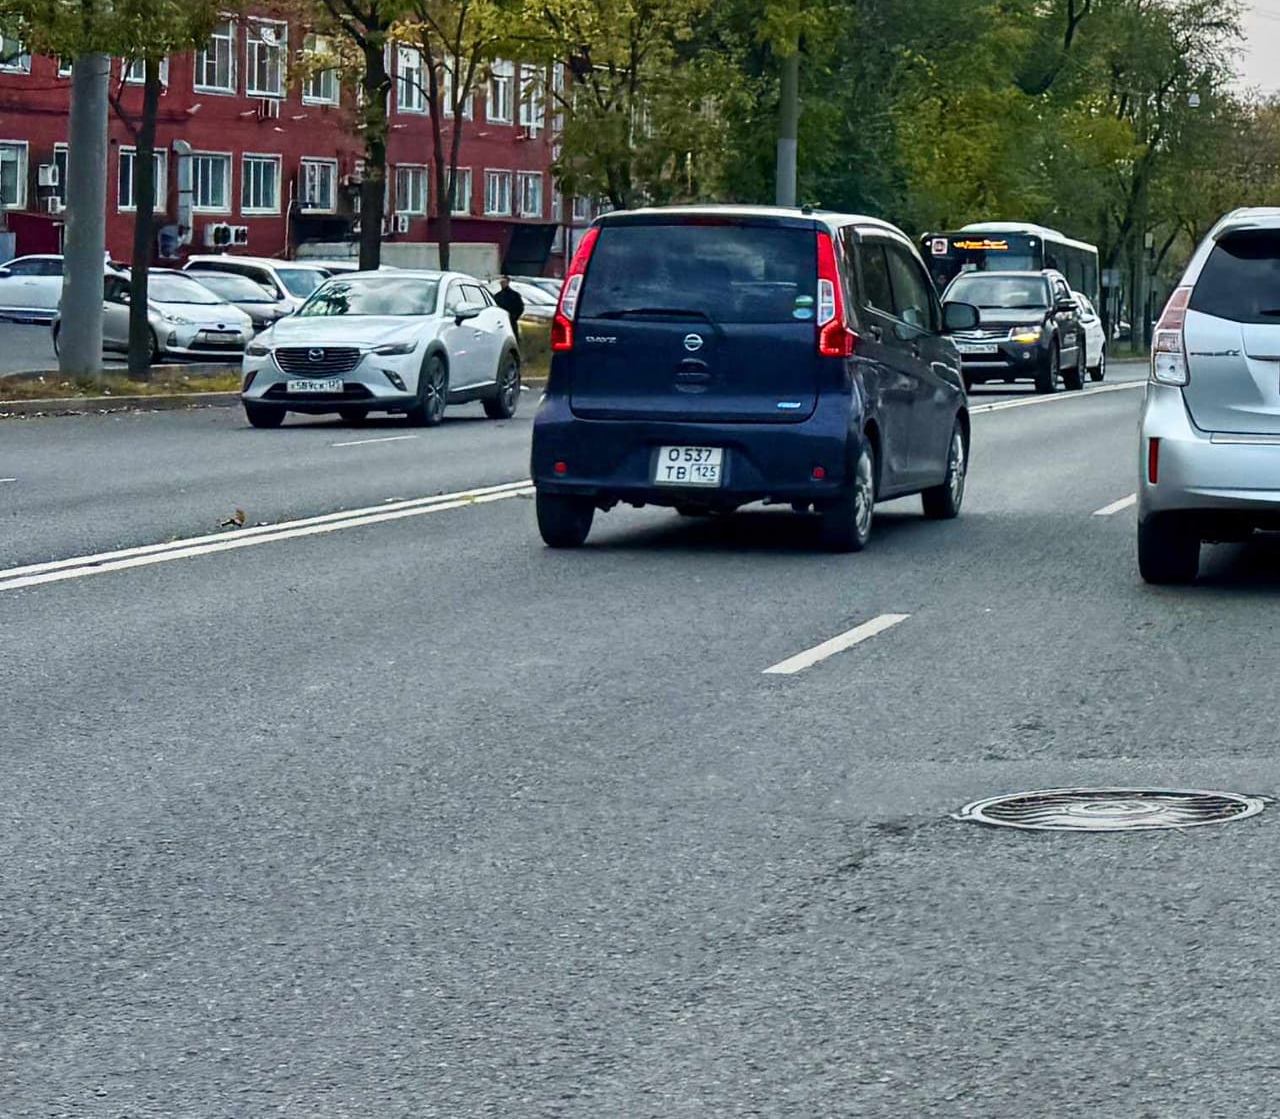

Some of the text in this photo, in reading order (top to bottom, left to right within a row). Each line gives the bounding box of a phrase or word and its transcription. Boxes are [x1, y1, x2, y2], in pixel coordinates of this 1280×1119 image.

[669, 448, 712, 462] О 537
[665, 465, 717, 480] ТВ 125
